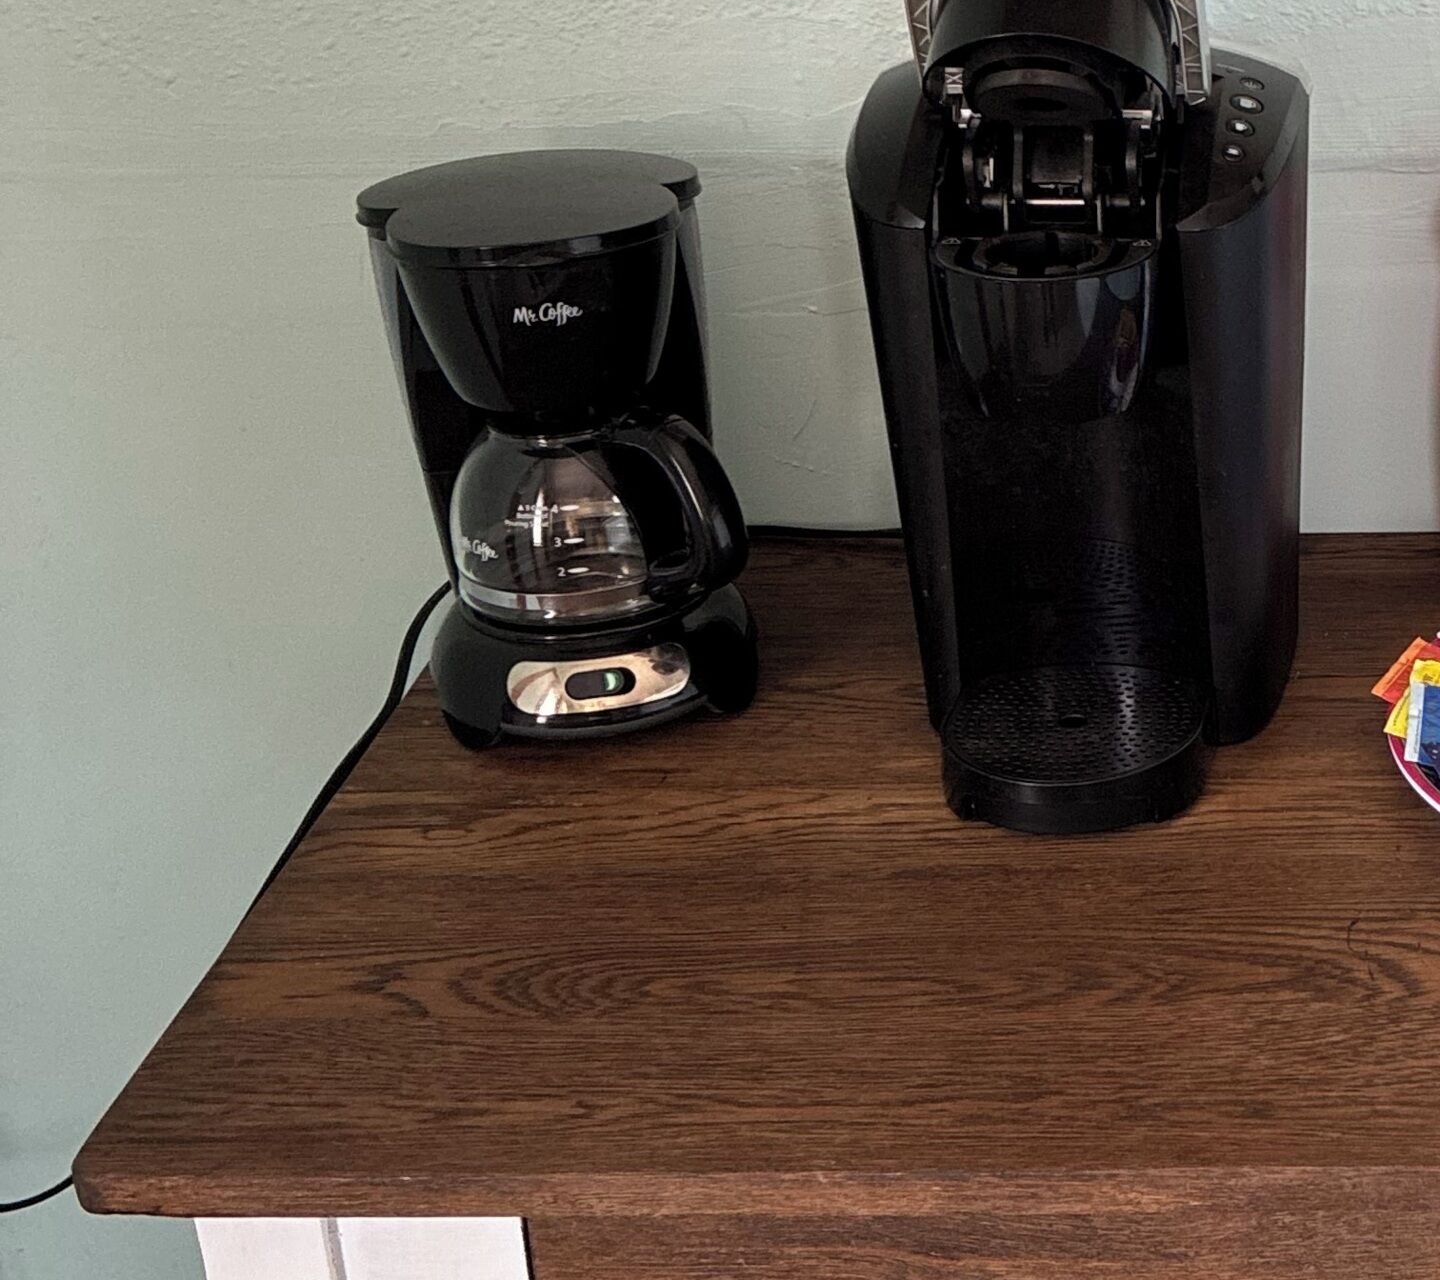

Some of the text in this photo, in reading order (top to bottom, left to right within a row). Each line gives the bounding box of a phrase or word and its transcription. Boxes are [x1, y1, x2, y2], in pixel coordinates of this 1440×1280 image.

[539, 301, 583, 327] Coffee
[553, 537, 562, 548] 3
[557, 567, 566, 577] 2
